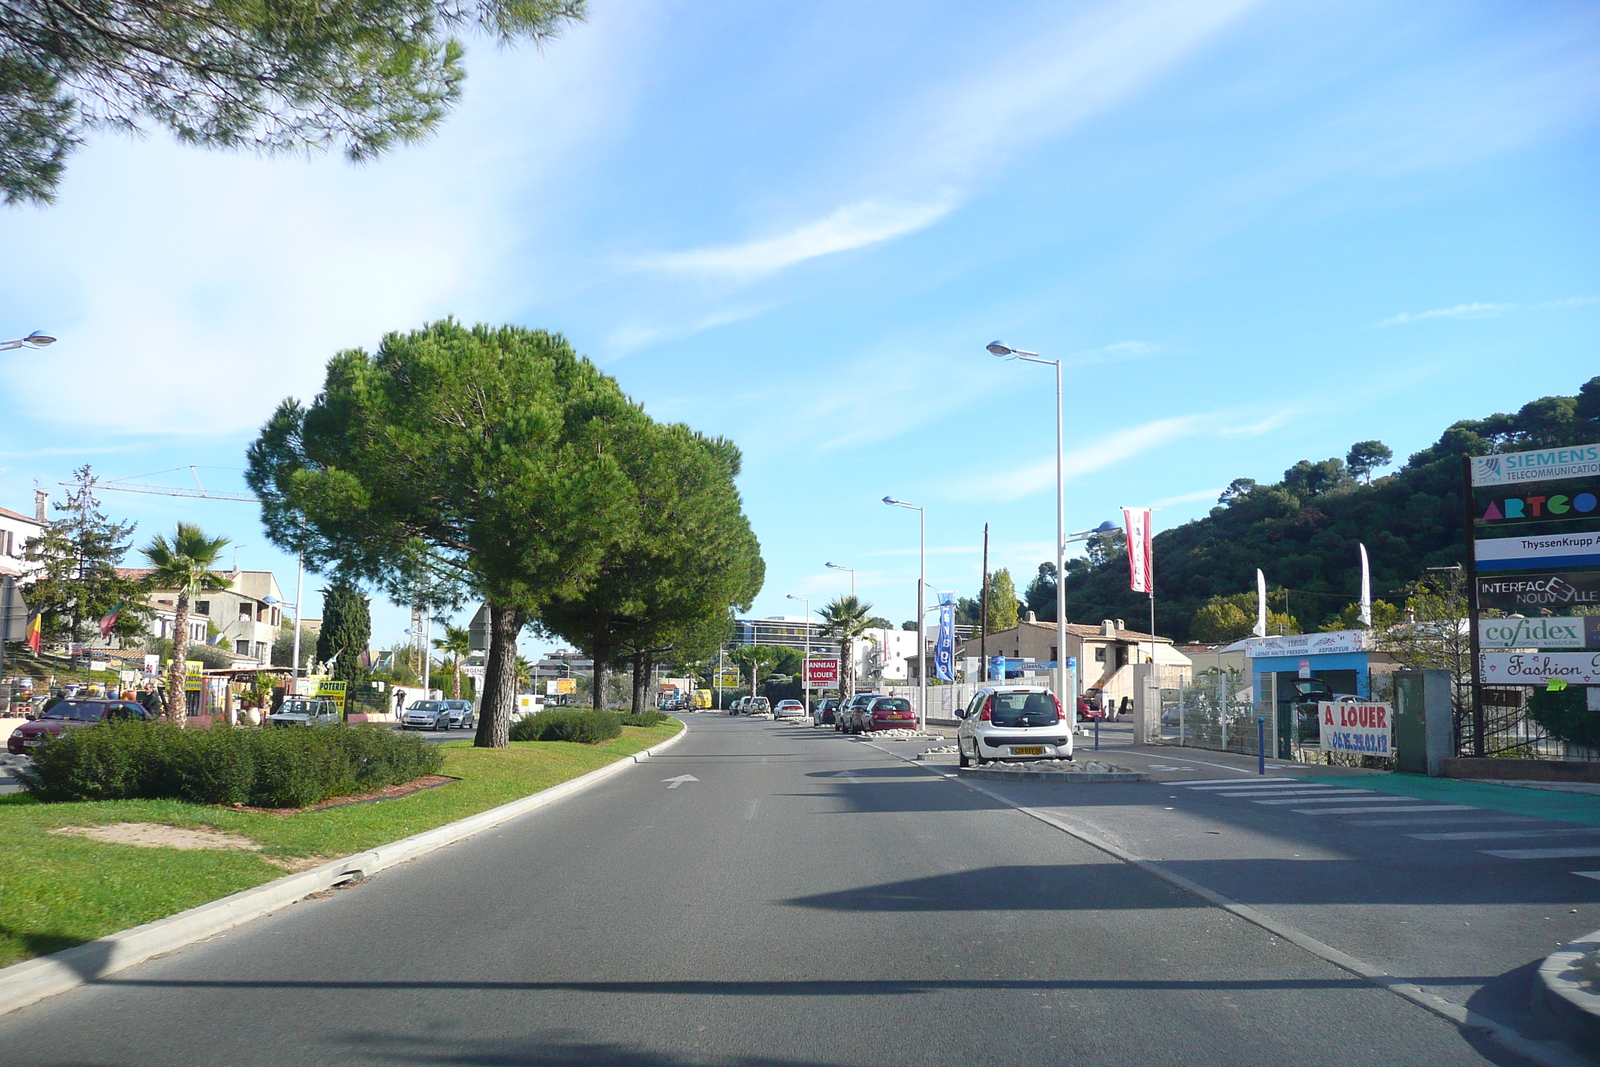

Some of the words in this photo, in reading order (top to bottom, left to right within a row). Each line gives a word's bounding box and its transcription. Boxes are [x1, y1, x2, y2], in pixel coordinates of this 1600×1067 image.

[1506, 447, 1598, 469] SIEMENS
[1507, 463, 1600, 480] TELECOMMUNICATIO
[1482, 492, 1598, 520] ARTCO
[1521, 537, 1593, 550] ThyssenKrupp
[1485, 619, 1578, 647] cofidex
[1507, 655, 1581, 676] Fashion
[320, 682, 346, 691] POTERIE
[1325, 705, 1334, 725] A
[1341, 706, 1387, 728] LOUER
